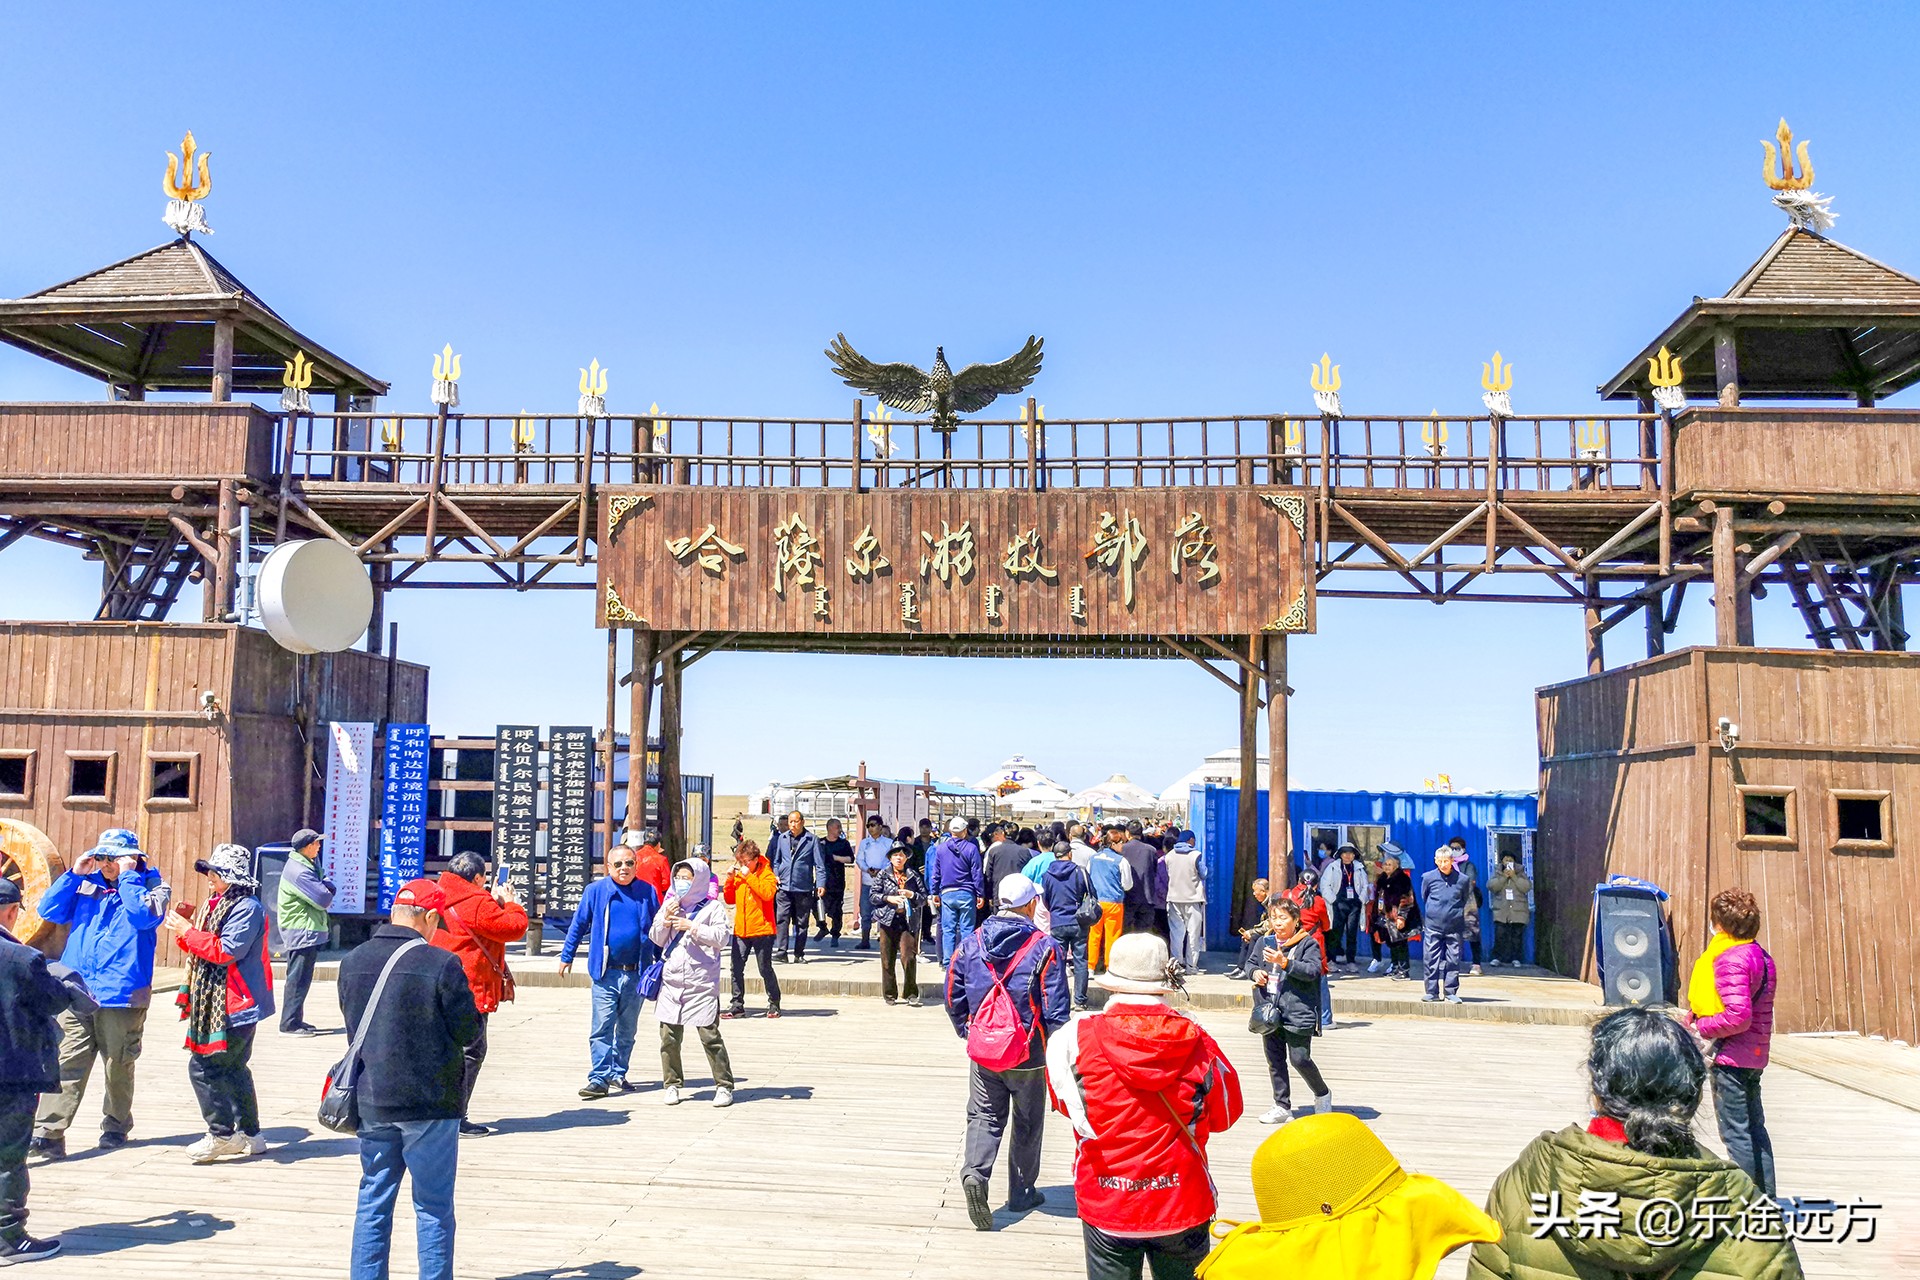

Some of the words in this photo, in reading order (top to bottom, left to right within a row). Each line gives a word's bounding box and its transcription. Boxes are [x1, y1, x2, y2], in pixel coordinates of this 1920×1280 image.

[397, 728, 425, 887] 呼和哈达边境派出所哈萨尔旅游
